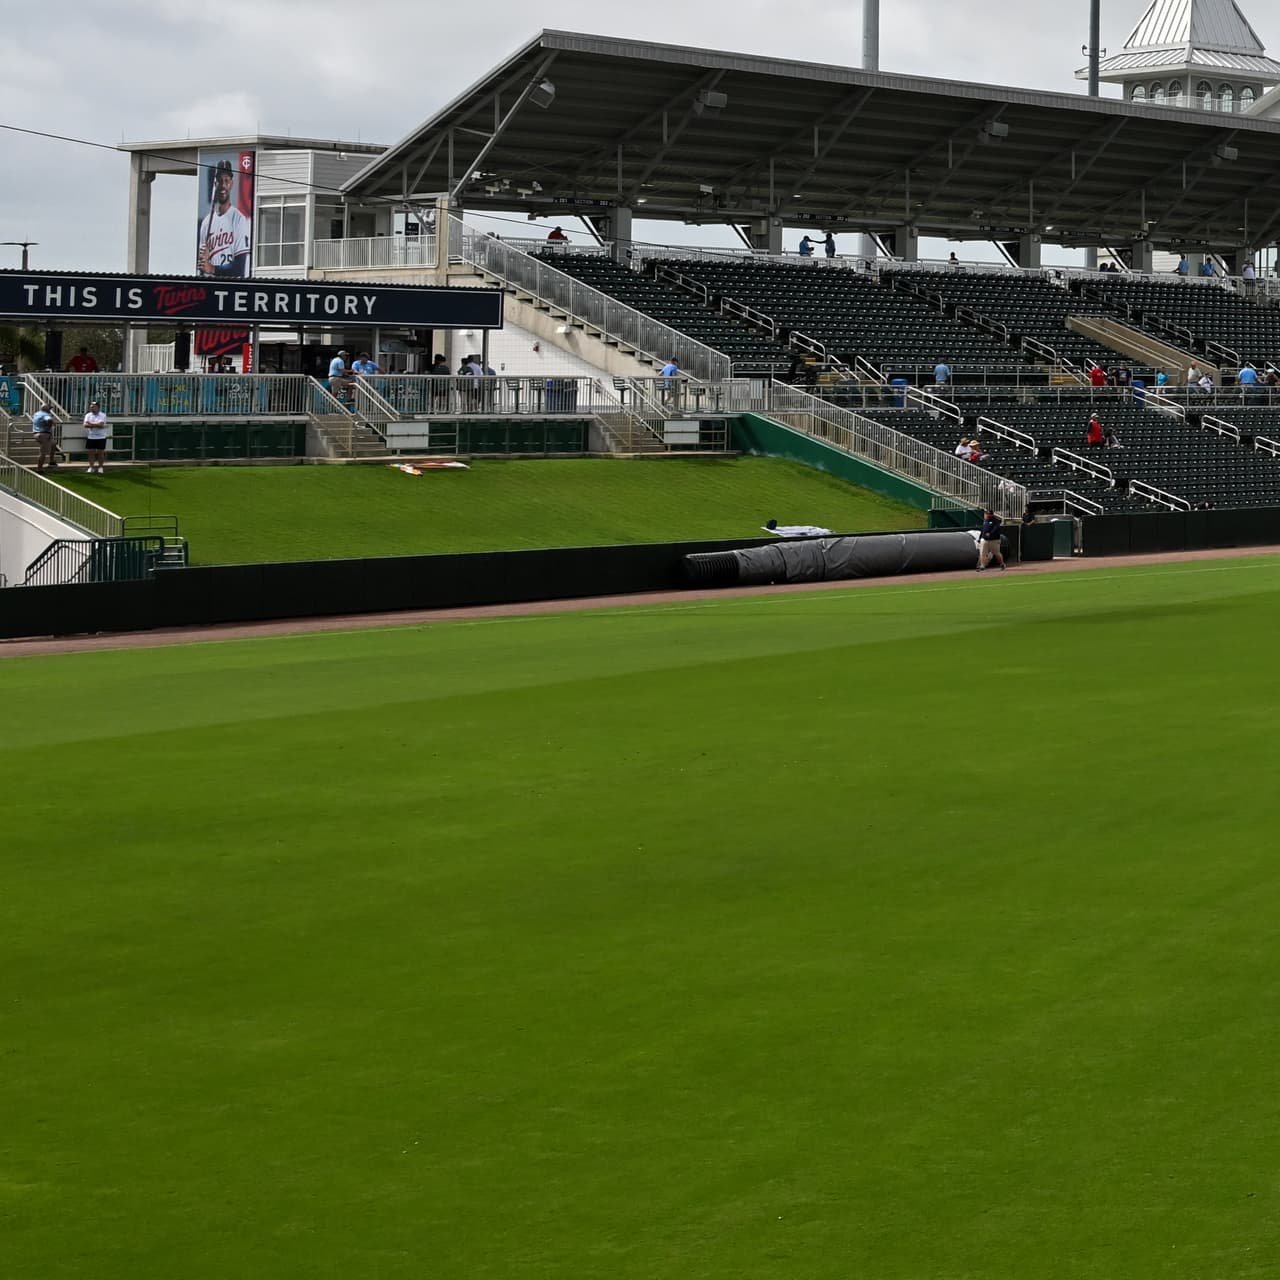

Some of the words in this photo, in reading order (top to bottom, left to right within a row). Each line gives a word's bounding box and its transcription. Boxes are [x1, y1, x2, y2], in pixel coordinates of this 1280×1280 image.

[24, 284, 98, 308] THIS
[116, 287, 143, 309] IS
[153, 285, 207, 314] Twins
[214, 290, 377, 316] TERRITORY
